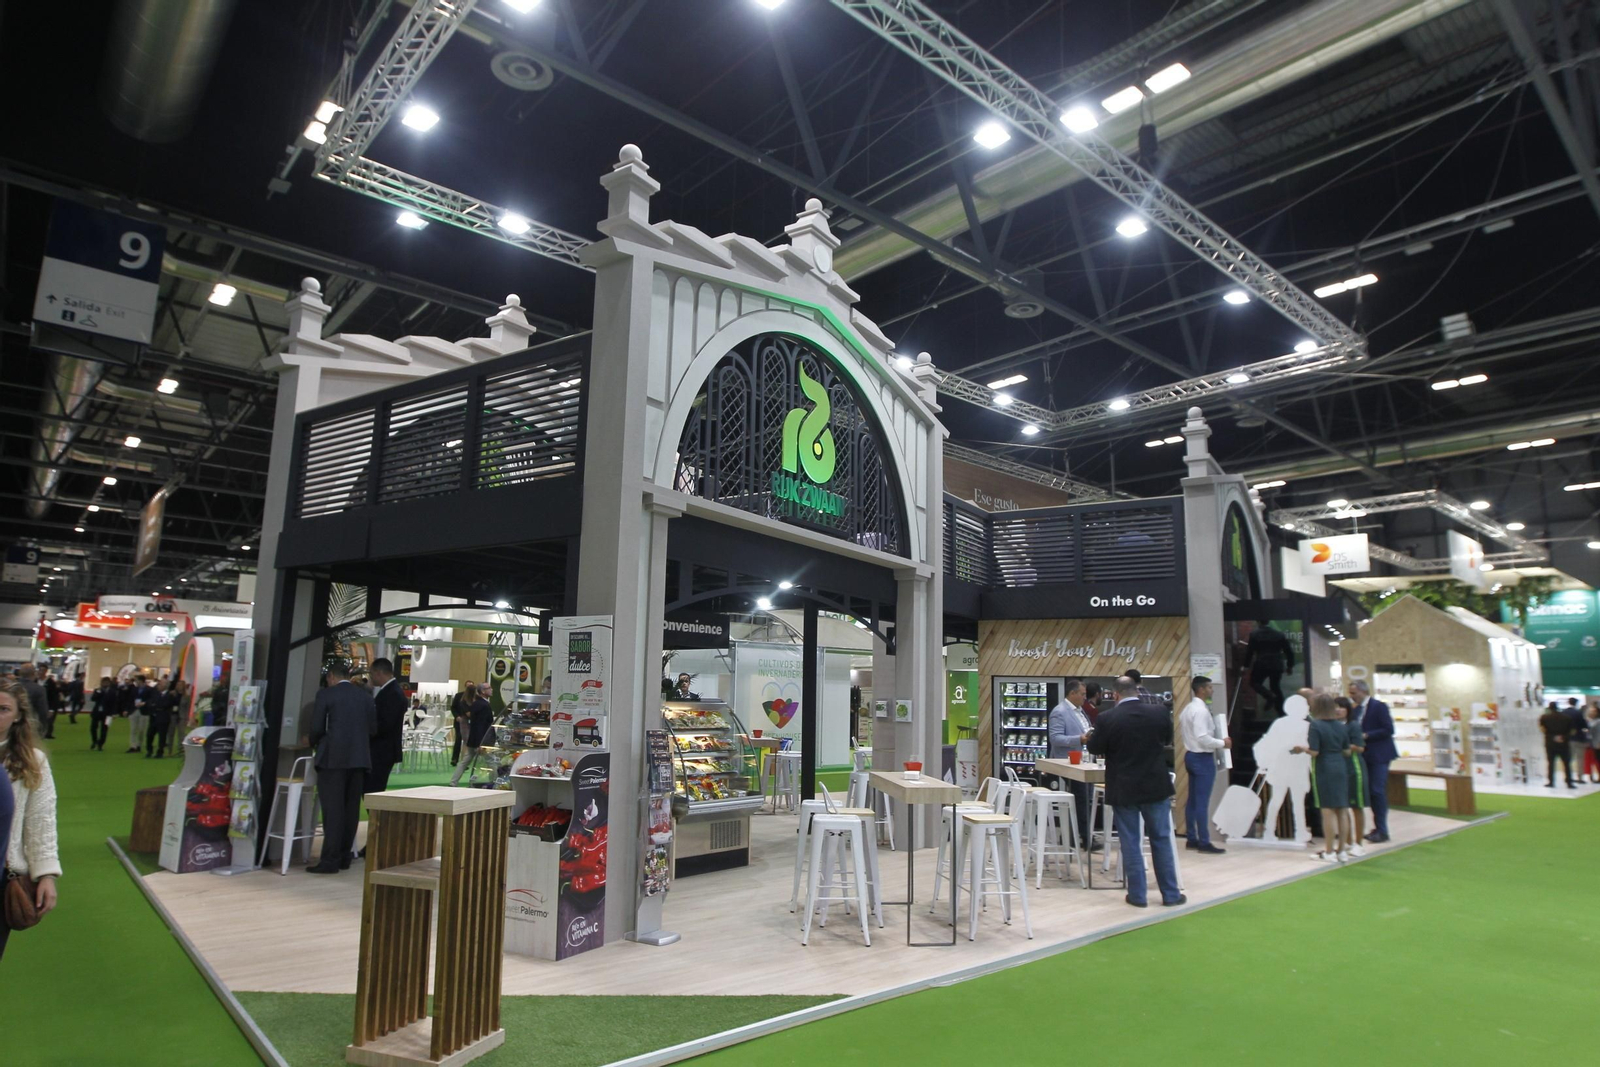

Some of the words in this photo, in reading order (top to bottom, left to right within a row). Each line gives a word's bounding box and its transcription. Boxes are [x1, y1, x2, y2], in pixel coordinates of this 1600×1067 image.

[119, 231, 151, 270] 9
[63, 297, 102, 313] Salida
[105, 307, 126, 319] Exit
[771, 470, 800, 503] RIJK
[801, 482, 845, 518] ZWAAN
[974, 488, 992, 506] Ese
[993, 498, 1020, 512] gusto
[26, 551, 37, 563] 9
[1333, 552, 1348, 562] DS
[1327, 560, 1358, 571] Smith
[145, 602, 174, 613] CASI
[1090, 596, 1109, 608] On
[1112, 595, 1133, 607] the
[1136, 595, 1156, 606] Go
[663, 619, 723, 636] onvenience
[570, 640, 591, 653] SABOR
[1008, 639, 1051, 660] Boost
[1054, 639, 1096, 659] Your
[1103, 638, 1139, 664] Day
[569, 659, 591, 672] dulce
[758, 658, 794, 669] CULTIVOS
[505, 905, 549, 919] weetPalermo
[571, 927, 594, 941] VITAMINA
[593, 922, 599, 933] C
